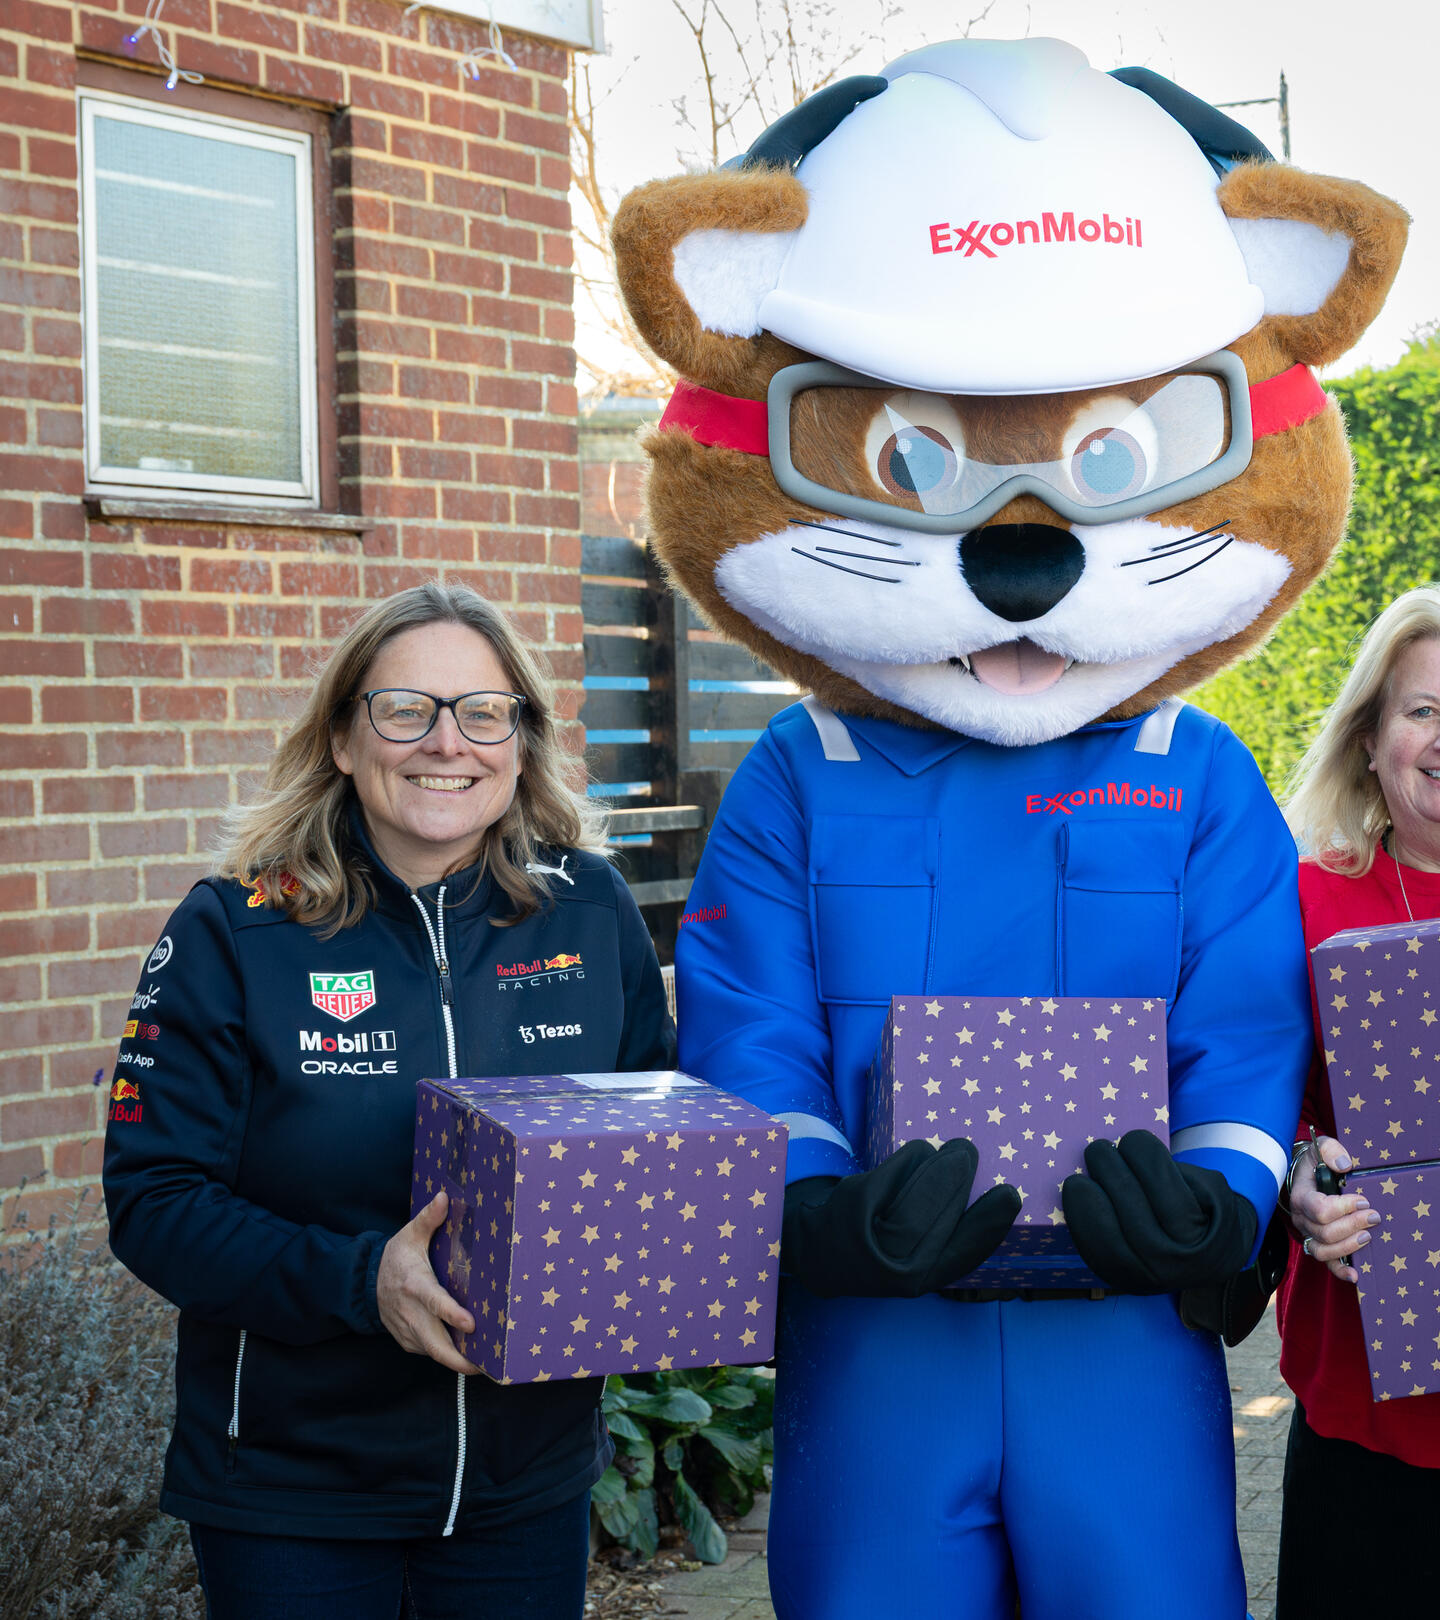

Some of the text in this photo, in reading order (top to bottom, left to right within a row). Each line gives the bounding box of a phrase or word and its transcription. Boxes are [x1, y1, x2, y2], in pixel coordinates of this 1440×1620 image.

[929, 211, 1143, 258] ExxonMobil
[1026, 782, 1183, 815] ExxonMobil
[680, 904, 727, 929] onMobil
[496, 960, 542, 976] Red Bull
[315, 975, 369, 991] TAG
[498, 971, 585, 991] RACING
[316, 993, 372, 1018] HEUER
[536, 1023, 582, 1039] Tezos
[299, 1030, 369, 1053] Mobil
[118, 1052, 155, 1068] ash App
[300, 1060, 398, 1075] ORACLE
[114, 1103, 143, 1123] Bull
